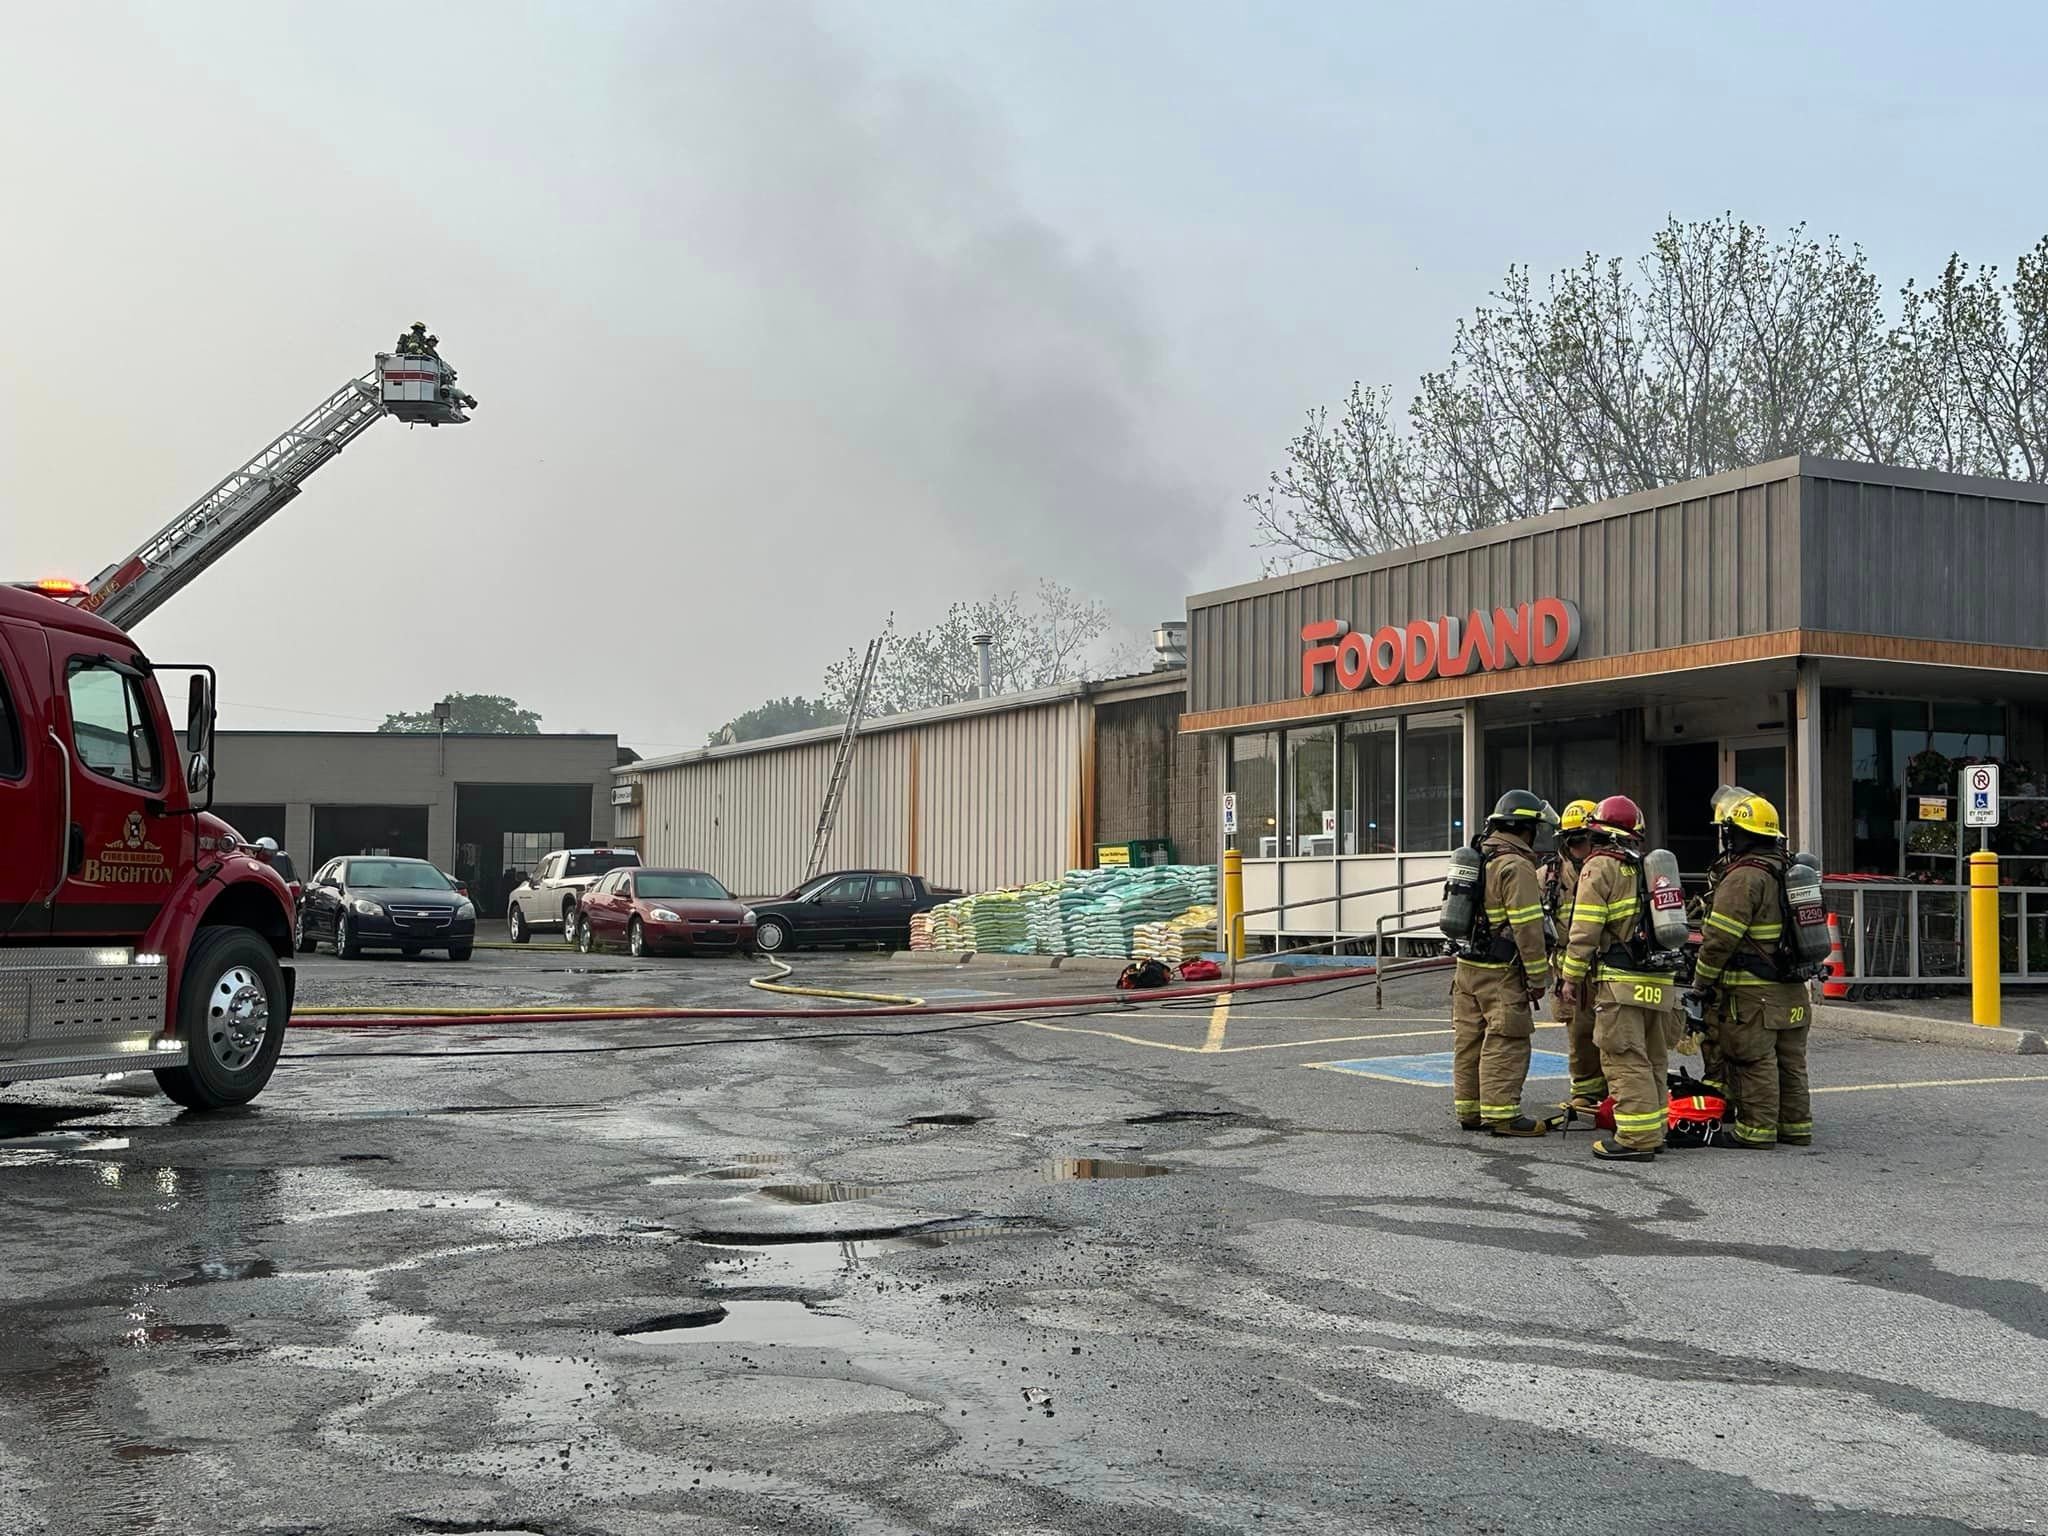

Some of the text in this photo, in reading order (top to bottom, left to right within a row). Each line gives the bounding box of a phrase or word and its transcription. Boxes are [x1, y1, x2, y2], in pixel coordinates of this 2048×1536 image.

[84, 859, 173, 883] BRIGHTON
[1800, 908, 1823, 921] R290
[1634, 984, 1663, 1005] 209
[1790, 1006, 1804, 1024] 20
